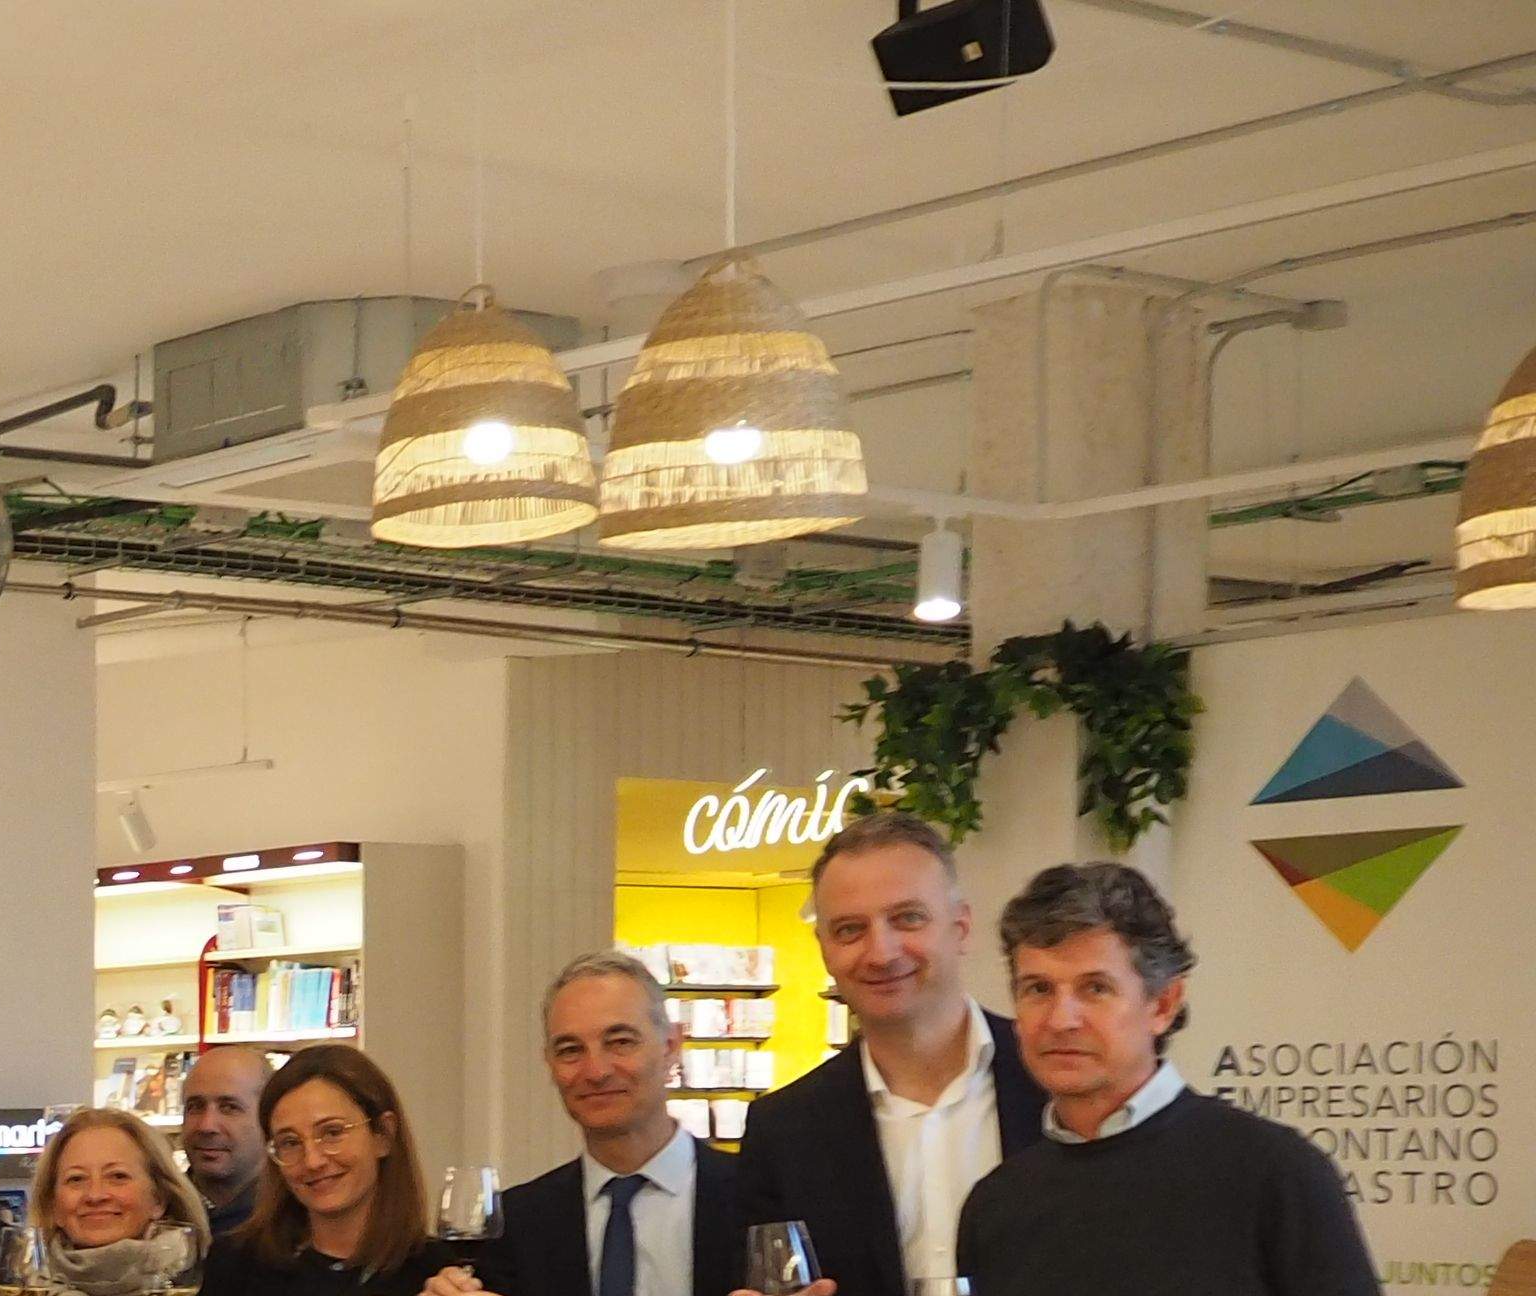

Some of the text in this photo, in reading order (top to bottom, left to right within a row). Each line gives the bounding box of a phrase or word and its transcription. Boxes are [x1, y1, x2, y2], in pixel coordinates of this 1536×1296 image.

[1212, 1031, 1499, 1077] ASOCIACIÓN
[1310, 1127, 1499, 1162] ONTANO
[1344, 1170, 1499, 1206] ASTRO
